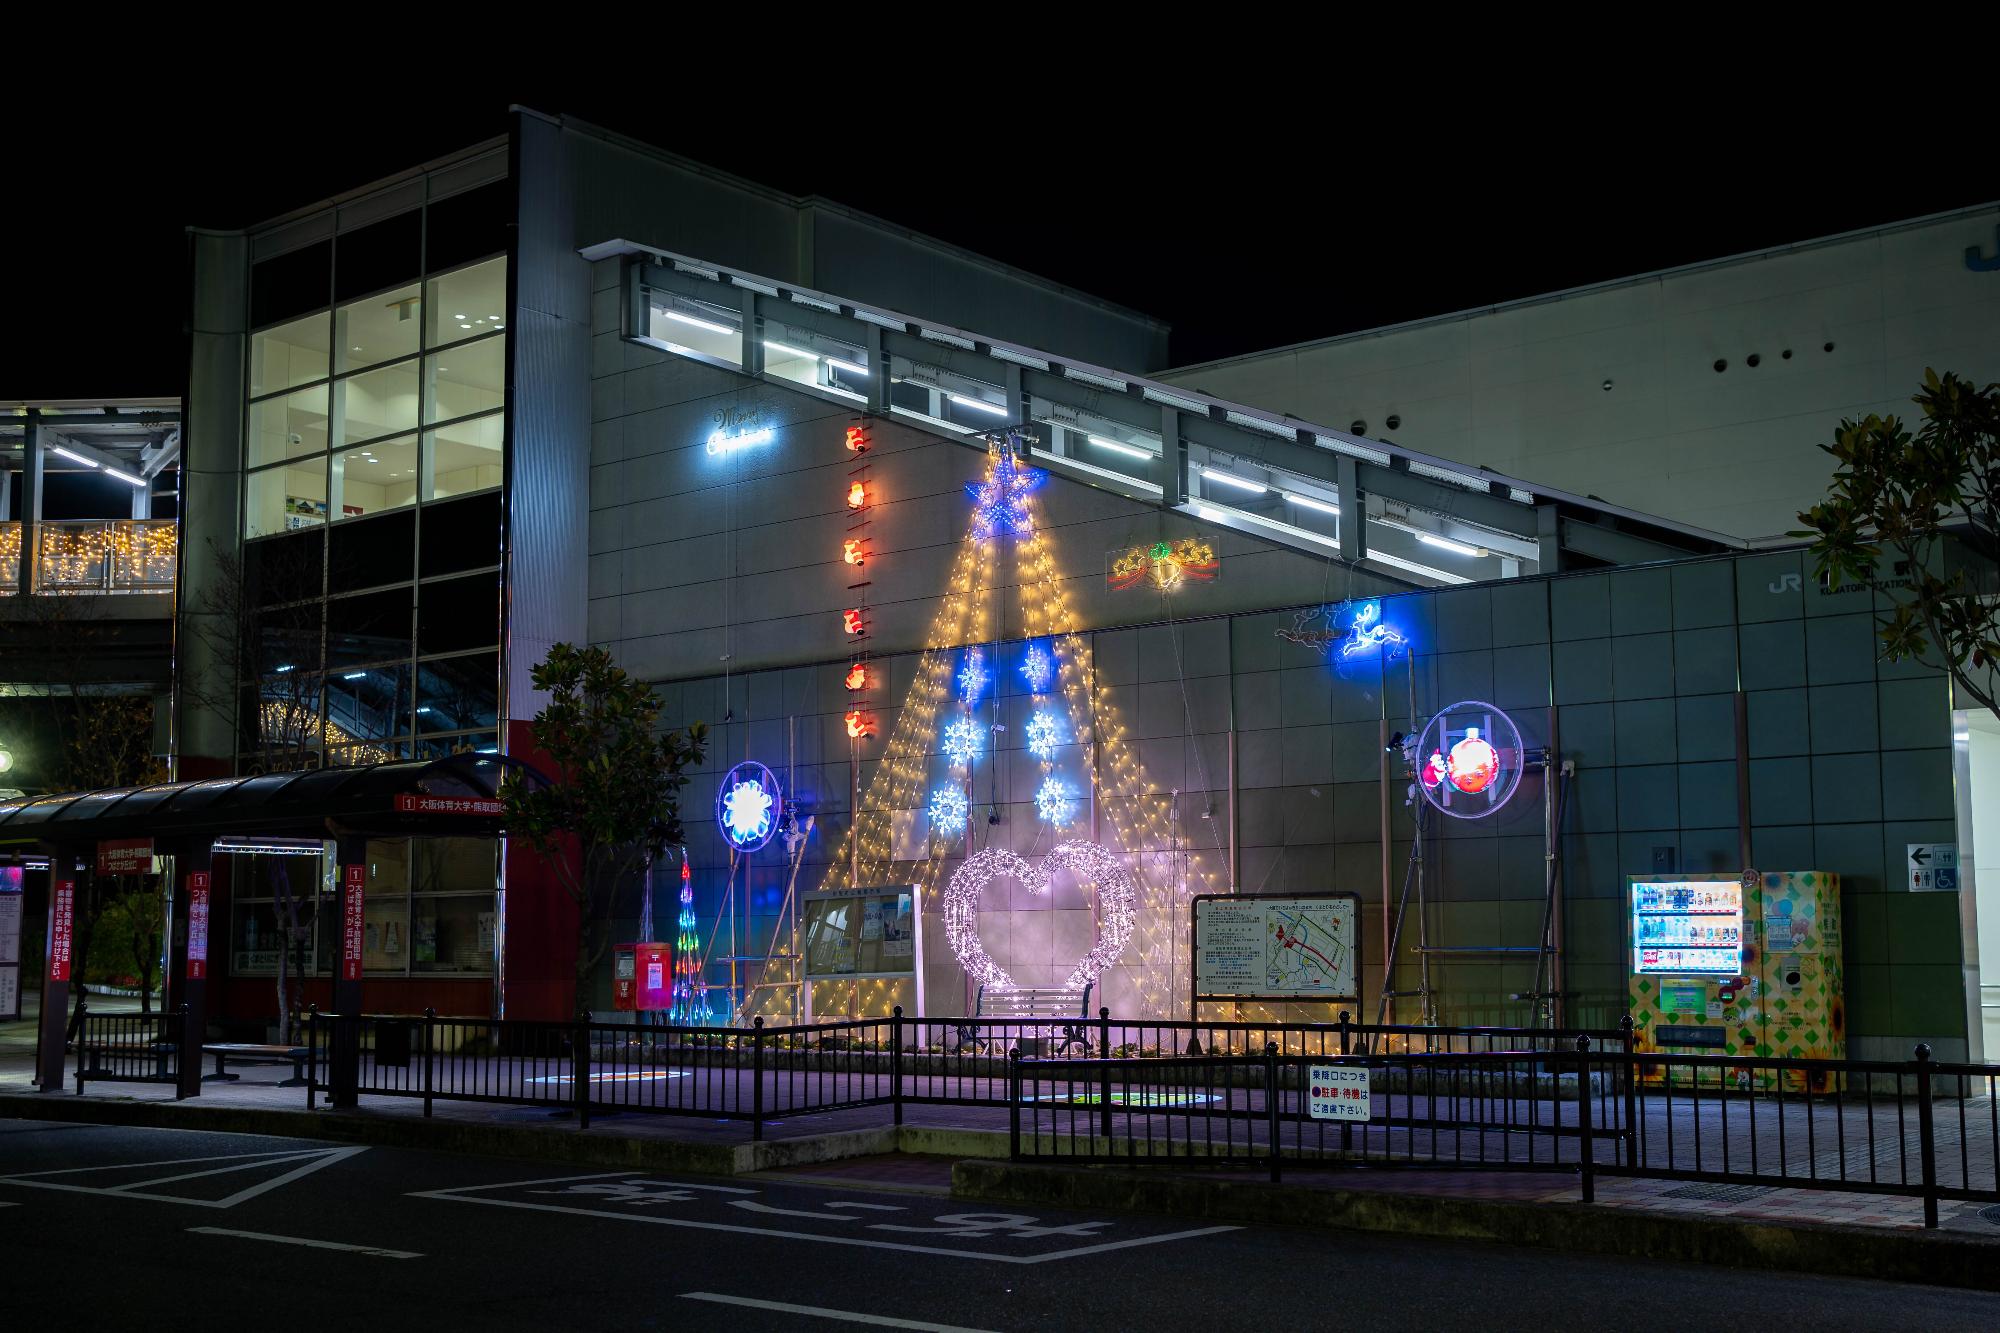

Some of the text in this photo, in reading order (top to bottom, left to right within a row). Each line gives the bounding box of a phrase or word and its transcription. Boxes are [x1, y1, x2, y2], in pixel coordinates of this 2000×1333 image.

[1768, 572, 1802, 594] JR
[1820, 583, 1866, 595] KUATORI
[1312, 1070, 1367, 1082] 乗降口につき
[1313, 1103, 1368, 1116] ご遠慮下さい。
